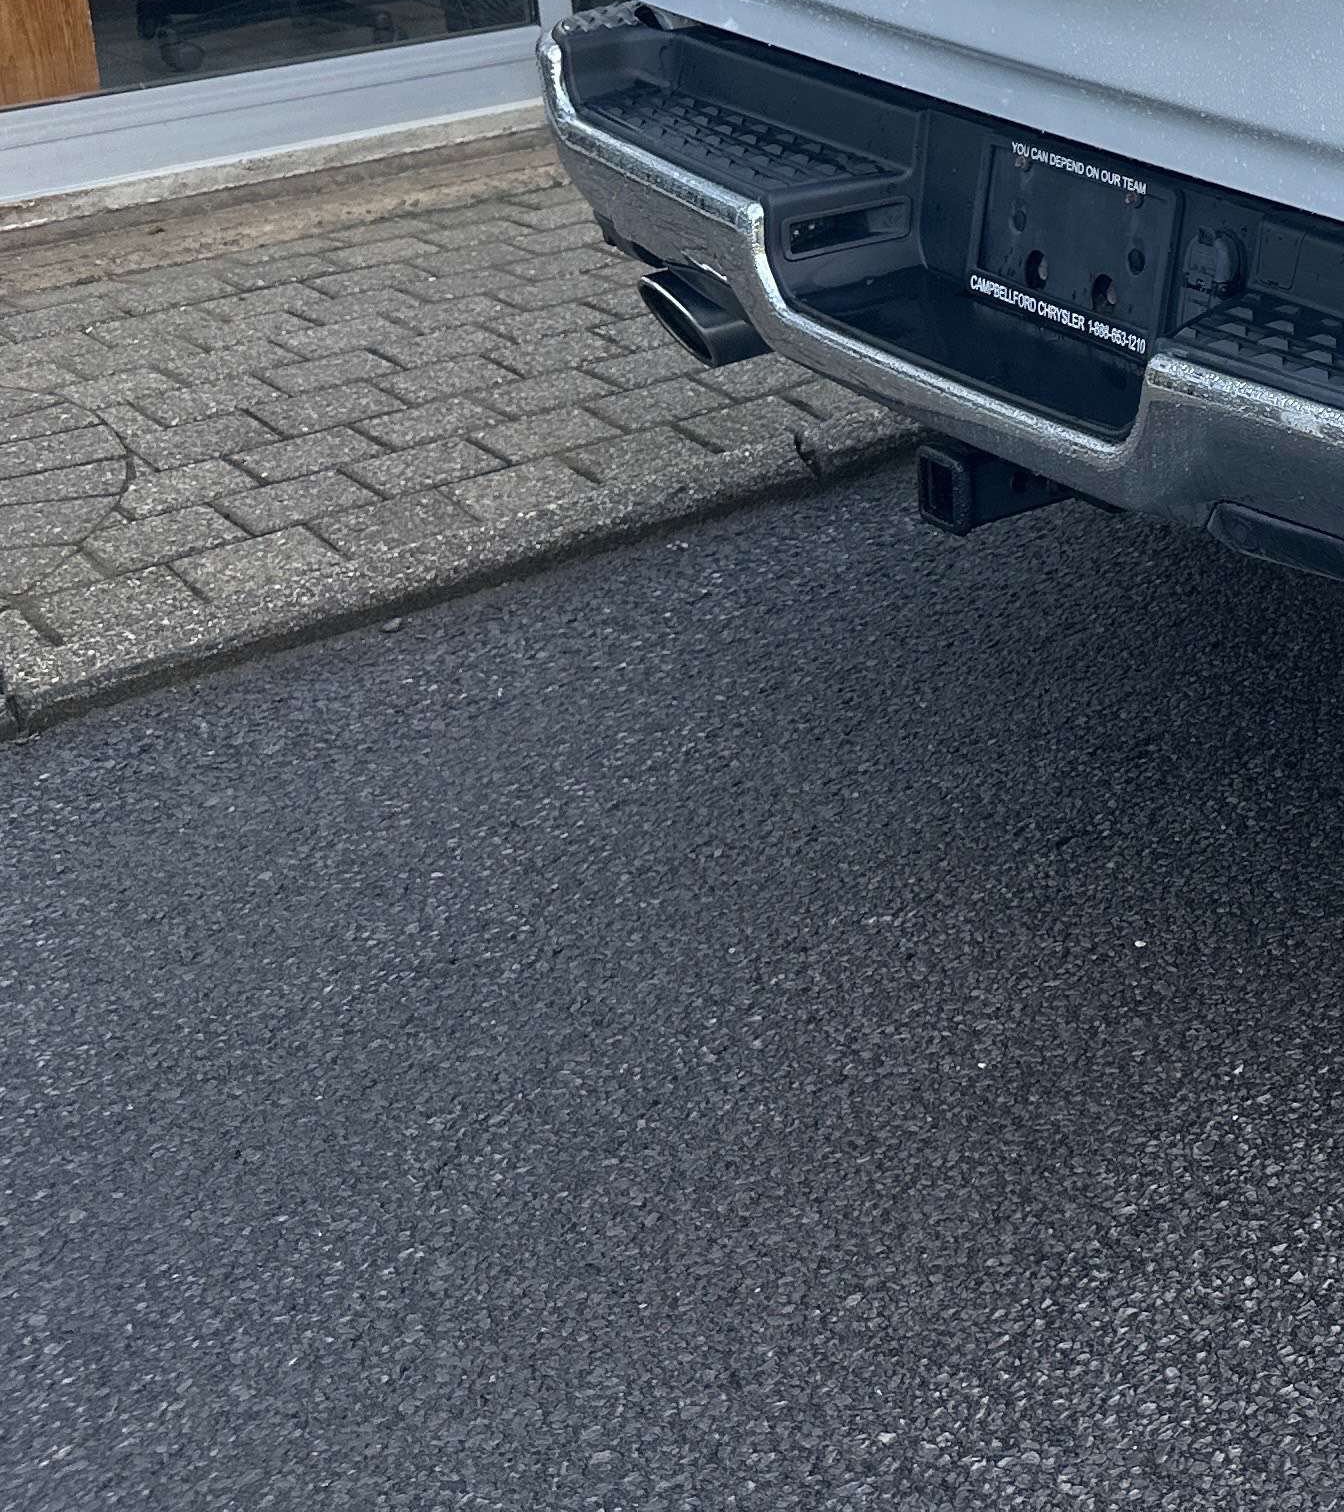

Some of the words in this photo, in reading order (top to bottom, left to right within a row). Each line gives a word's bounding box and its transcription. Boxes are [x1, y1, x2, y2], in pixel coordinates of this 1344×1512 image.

[1012, 141, 1030, 158] YOU
[1031, 147, 1049, 164] CAN
[1050, 151, 1084, 175] DEPEND
[1086, 164, 1099, 180] ON
[1101, 169, 1121, 187] OUR
[1122, 175, 1147, 195] TEAM
[970, 275, 1036, 313] CAMPBELLFORD
[1038, 300, 1085, 332] CHRYSLER
